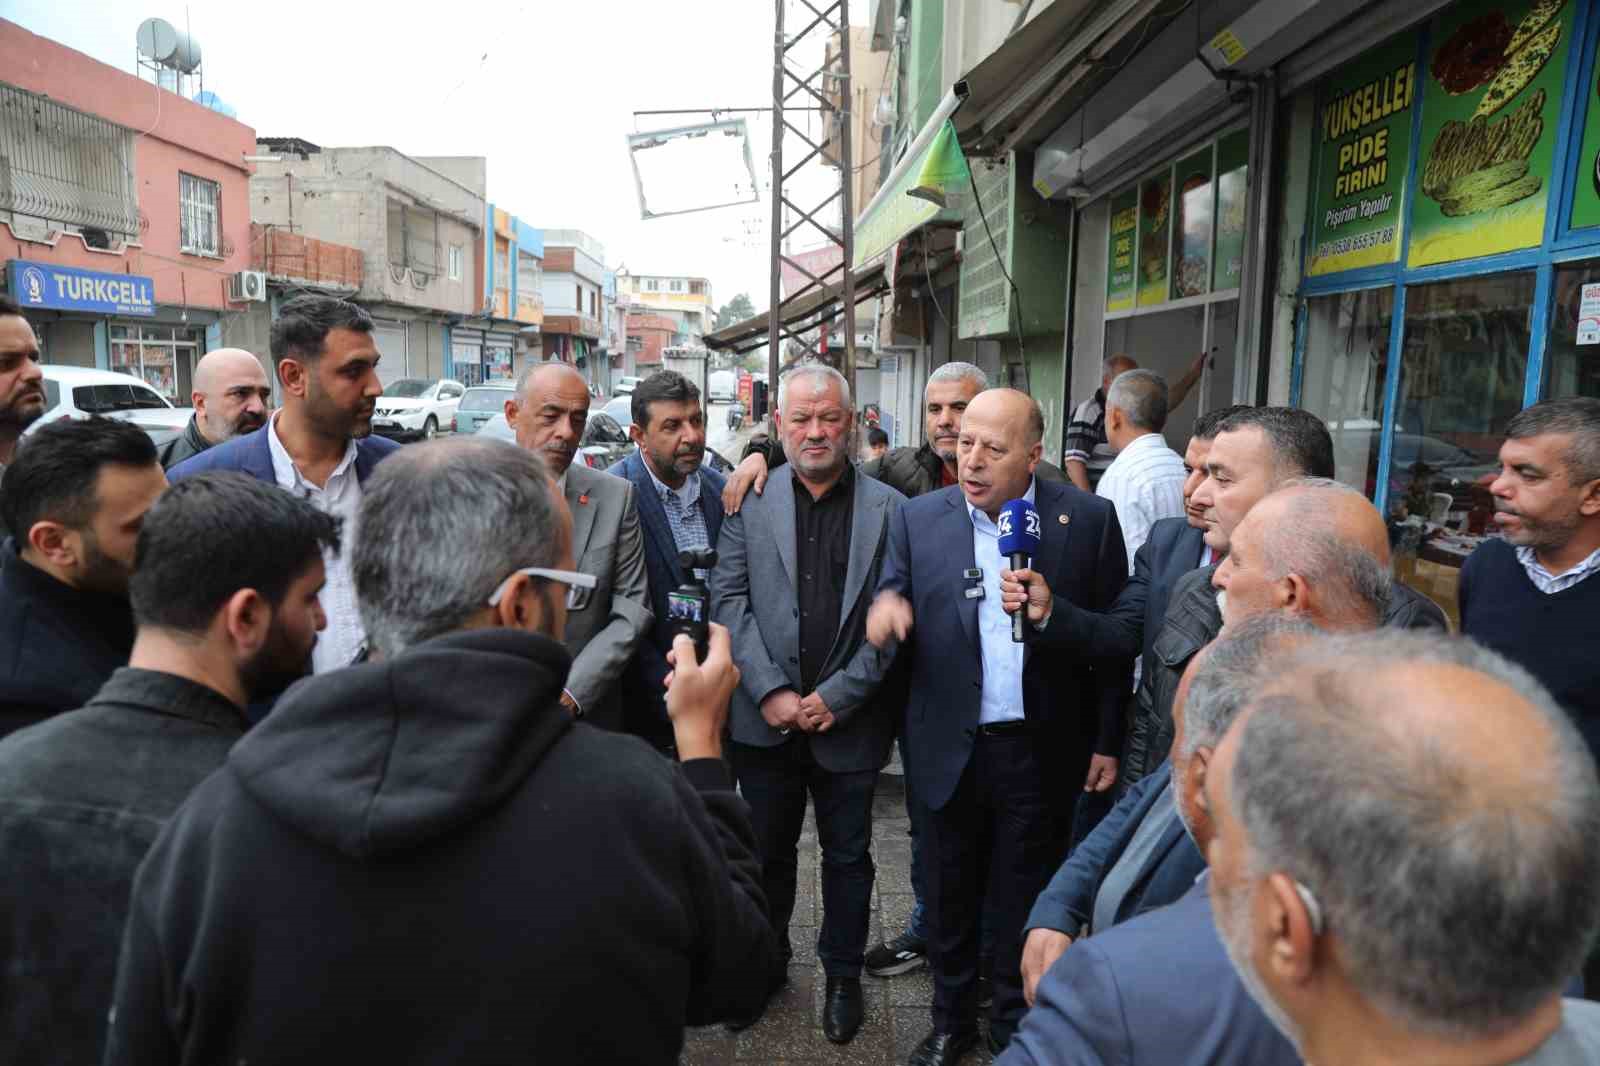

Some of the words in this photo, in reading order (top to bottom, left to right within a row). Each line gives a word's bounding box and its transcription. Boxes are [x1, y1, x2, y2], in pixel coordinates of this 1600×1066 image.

[1339, 128, 1388, 172] PİDE
[1335, 160, 1388, 199] FIRINI
[54, 273, 152, 305] TURKCELL
